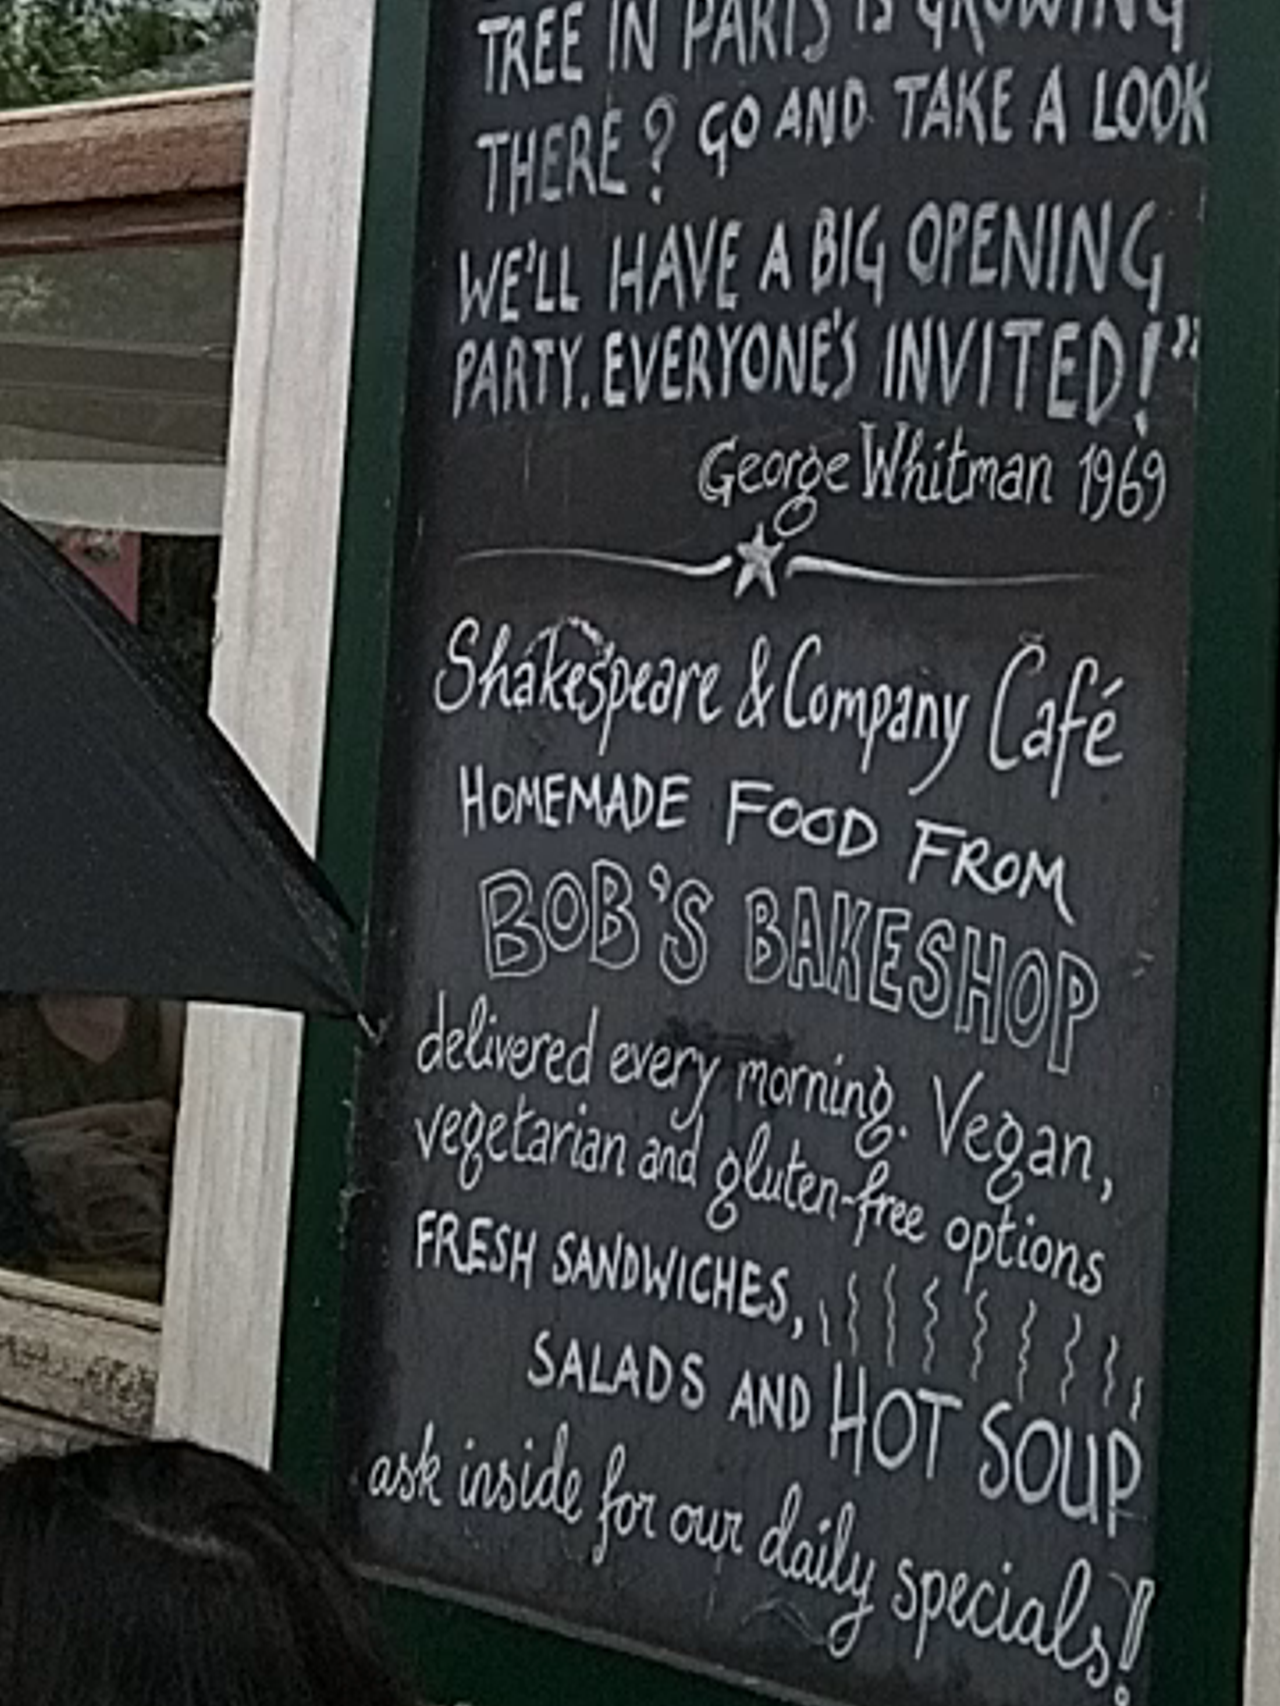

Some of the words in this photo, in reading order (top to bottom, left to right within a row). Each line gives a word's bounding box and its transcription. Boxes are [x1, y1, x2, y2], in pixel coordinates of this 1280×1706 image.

[476, 0, 583, 96] TREE
[698, 100, 760, 178] GO
[774, 76, 868, 147] AND
[894, 65, 1014, 144] TAKE
[1033, 65, 1067, 144] A
[1093, 61, 1210, 144] LOOK
[458, 237, 580, 324] WE'LL
[609, 219, 743, 315] HAVE
[759, 222, 791, 291] A
[811, 205, 886, 304] BIG
[907, 199, 1165, 313] OPENING
[604, 308, 857, 406] EVERYONE'S
[699, 437, 851, 537] George
[859, 422, 1053, 505] Whitman
[1077, 446, 1166, 522] 1969
[435, 615, 723, 756] Shakespeare
[736, 635, 774, 727] &
[783, 634, 969, 796] Company
[989, 642, 1124, 799] Café
[459, 766, 691, 836] HOMEMADE
[725, 781, 879, 857] FOOD
[909, 819, 1076, 925] FROM
[480, 858, 713, 984] BOB'S
[745, 887, 1099, 1074] BAKESHOP
[417, 991, 600, 1085] delivered
[609, 1038, 719, 1130] every
[737, 1053, 909, 1158] morning.
[932, 1070, 1114, 1202] Vegan,
[416, 1095, 626, 1188] vegetarian
[638, 1114, 699, 1188] and
[707, 1123, 926, 1246] gluten-free
[946, 1210, 1104, 1295] options
[417, 1209, 537, 1288] FRESH
[552, 1232, 805, 1339] SANDWICHES,
[527, 1330, 706, 1409] SALADS
[729, 1371, 810, 1431] AND
[829, 1361, 963, 1479] HOT
[978, 1400, 1143, 1539] SOUP
[369, 1422, 442, 1506] ask
[458, 1422, 583, 1525] inside
[592, 1442, 656, 1565] for
[670, 1500, 744, 1555] our
[759, 1482, 875, 1658] daily
